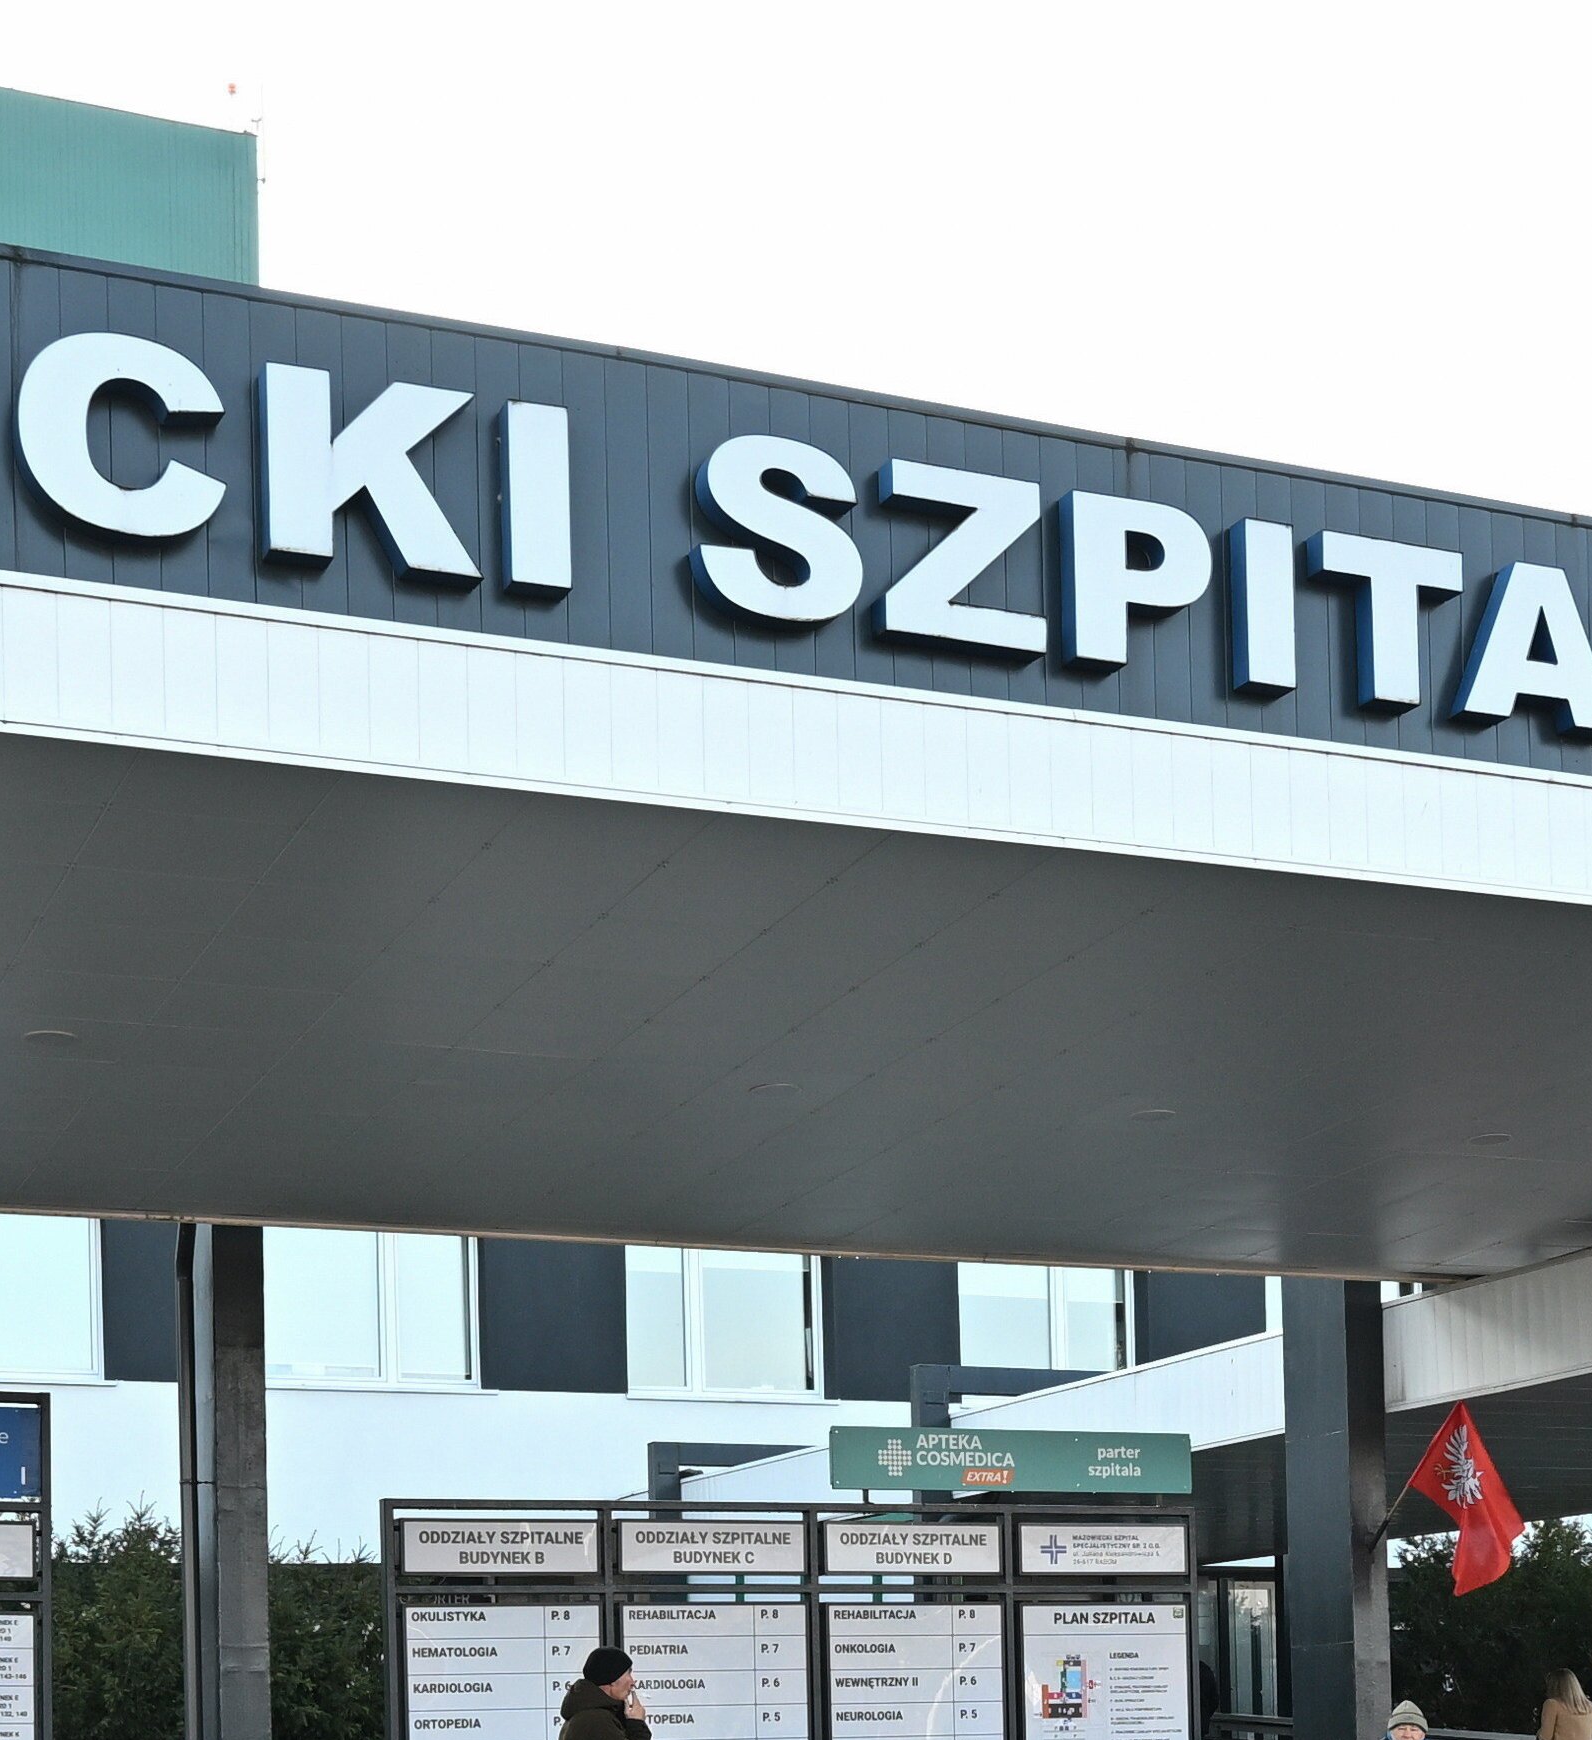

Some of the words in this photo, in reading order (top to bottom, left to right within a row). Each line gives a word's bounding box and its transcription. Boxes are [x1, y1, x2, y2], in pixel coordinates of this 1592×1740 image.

[916, 1434, 982, 1450] APTEKA
[916, 1451, 1015, 1467] COSMEDICA
[1098, 1446, 1140, 1461] parter
[1088, 1463, 1141, 1479] szpitala
[966, 1471, 1008, 1484] EXTRA!
[419, 1530, 496, 1544] ODDZIAŁY
[500, 1531, 583, 1544] SZPITALNE
[635, 1531, 708, 1544] ODDZIAŁY
[712, 1531, 791, 1545] SZPITALNE
[840, 1532, 908, 1545] ODDZIAŁY
[912, 1533, 987, 1546] SZPITALNE
[459, 1551, 531, 1564] BUDYNEK
[535, 1551, 545, 1564] B
[673, 1551, 741, 1564] BUDYNEK
[745, 1551, 754, 1564] C
[876, 1552, 940, 1564] BUDYNEK
[943, 1553, 952, 1565] D
[411, 1611, 486, 1622] OKULISTYKA
[551, 1610, 560, 1620] P.
[563, 1610, 570, 1620] 8
[629, 1609, 716, 1620] REHABILITACJA
[834, 1610, 916, 1620] REHABILITACJA
[1054, 1612, 1089, 1624] PLAN
[1093, 1612, 1155, 1624] SZPITALA
[412, 1647, 498, 1658] HEMATOLOGIA
[552, 1646, 560, 1656] P.
[564, 1645, 570, 1656] 7
[629, 1644, 688, 1655] PEDIATRIA
[834, 1643, 896, 1654] ONKOLOGIA
[413, 1682, 493, 1694] KARDIOLOGIA
[552, 1681, 562, 1691] P.
[835, 1677, 909, 1689] WEWNĘTRZNY
[912, 1677, 918, 1686] II
[648, 1714, 694, 1724] TOPEDIA
[836, 1711, 903, 1721] NEUROLOGIA
[414, 1718, 481, 1730] ORTOPEDIA
